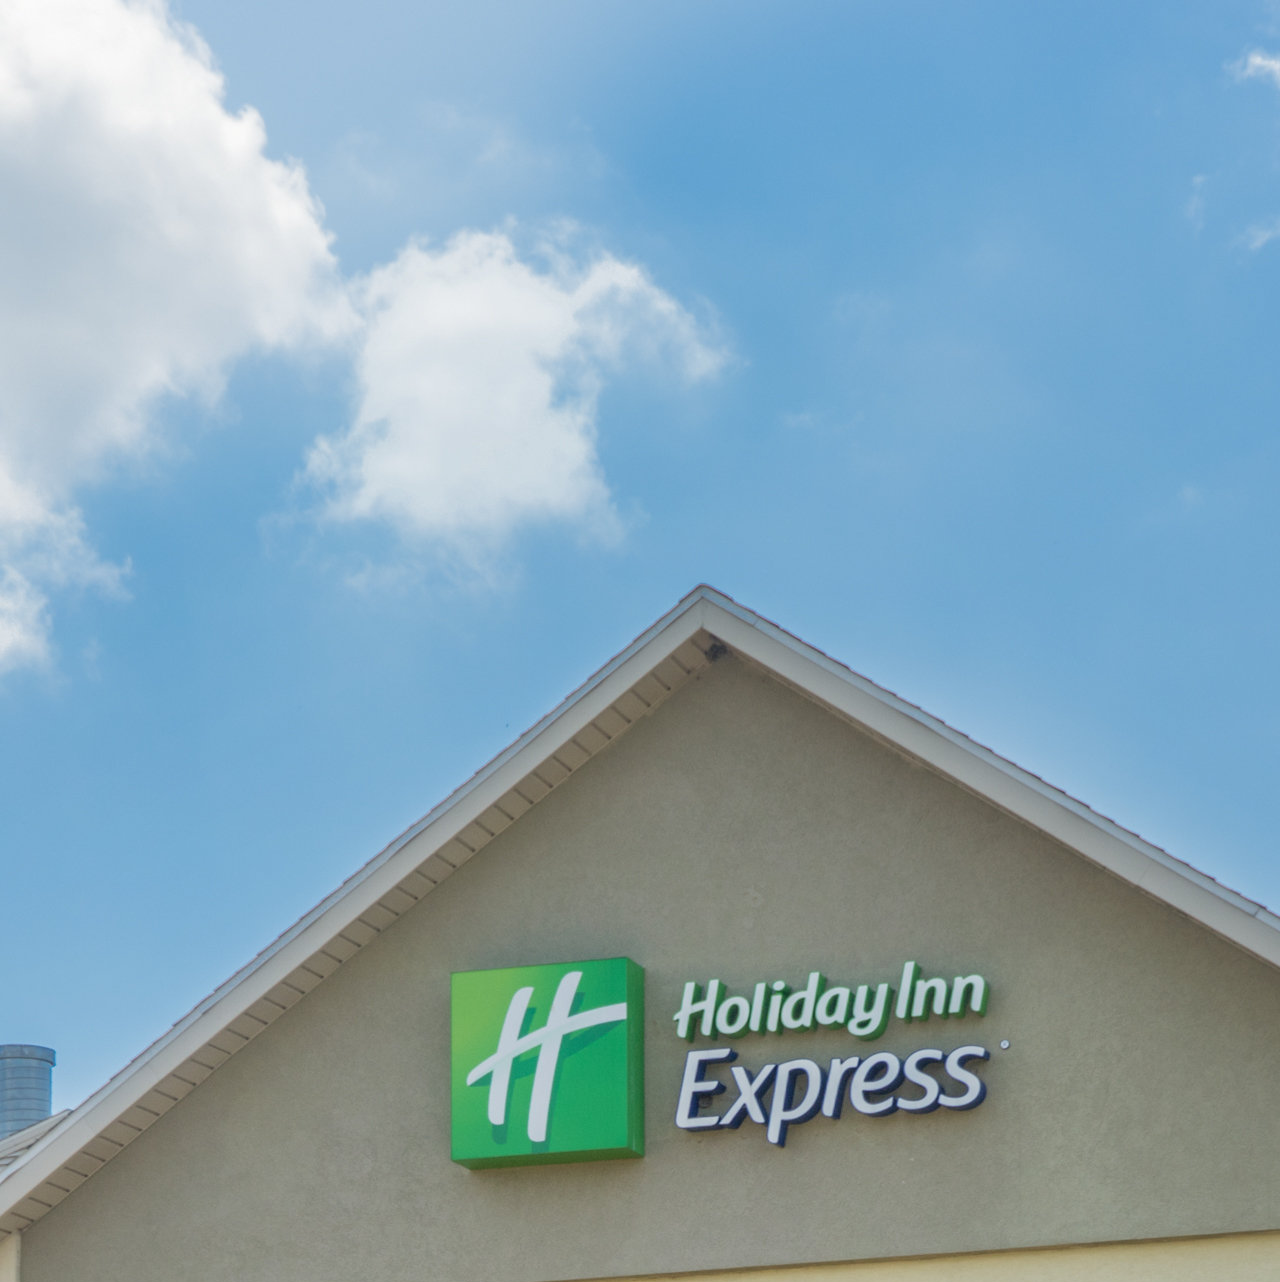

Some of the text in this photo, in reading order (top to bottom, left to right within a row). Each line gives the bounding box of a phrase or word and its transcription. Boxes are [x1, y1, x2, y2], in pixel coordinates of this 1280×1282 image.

[673, 961, 988, 1040] Holiday Inn
[675, 1046, 989, 1146] Express
